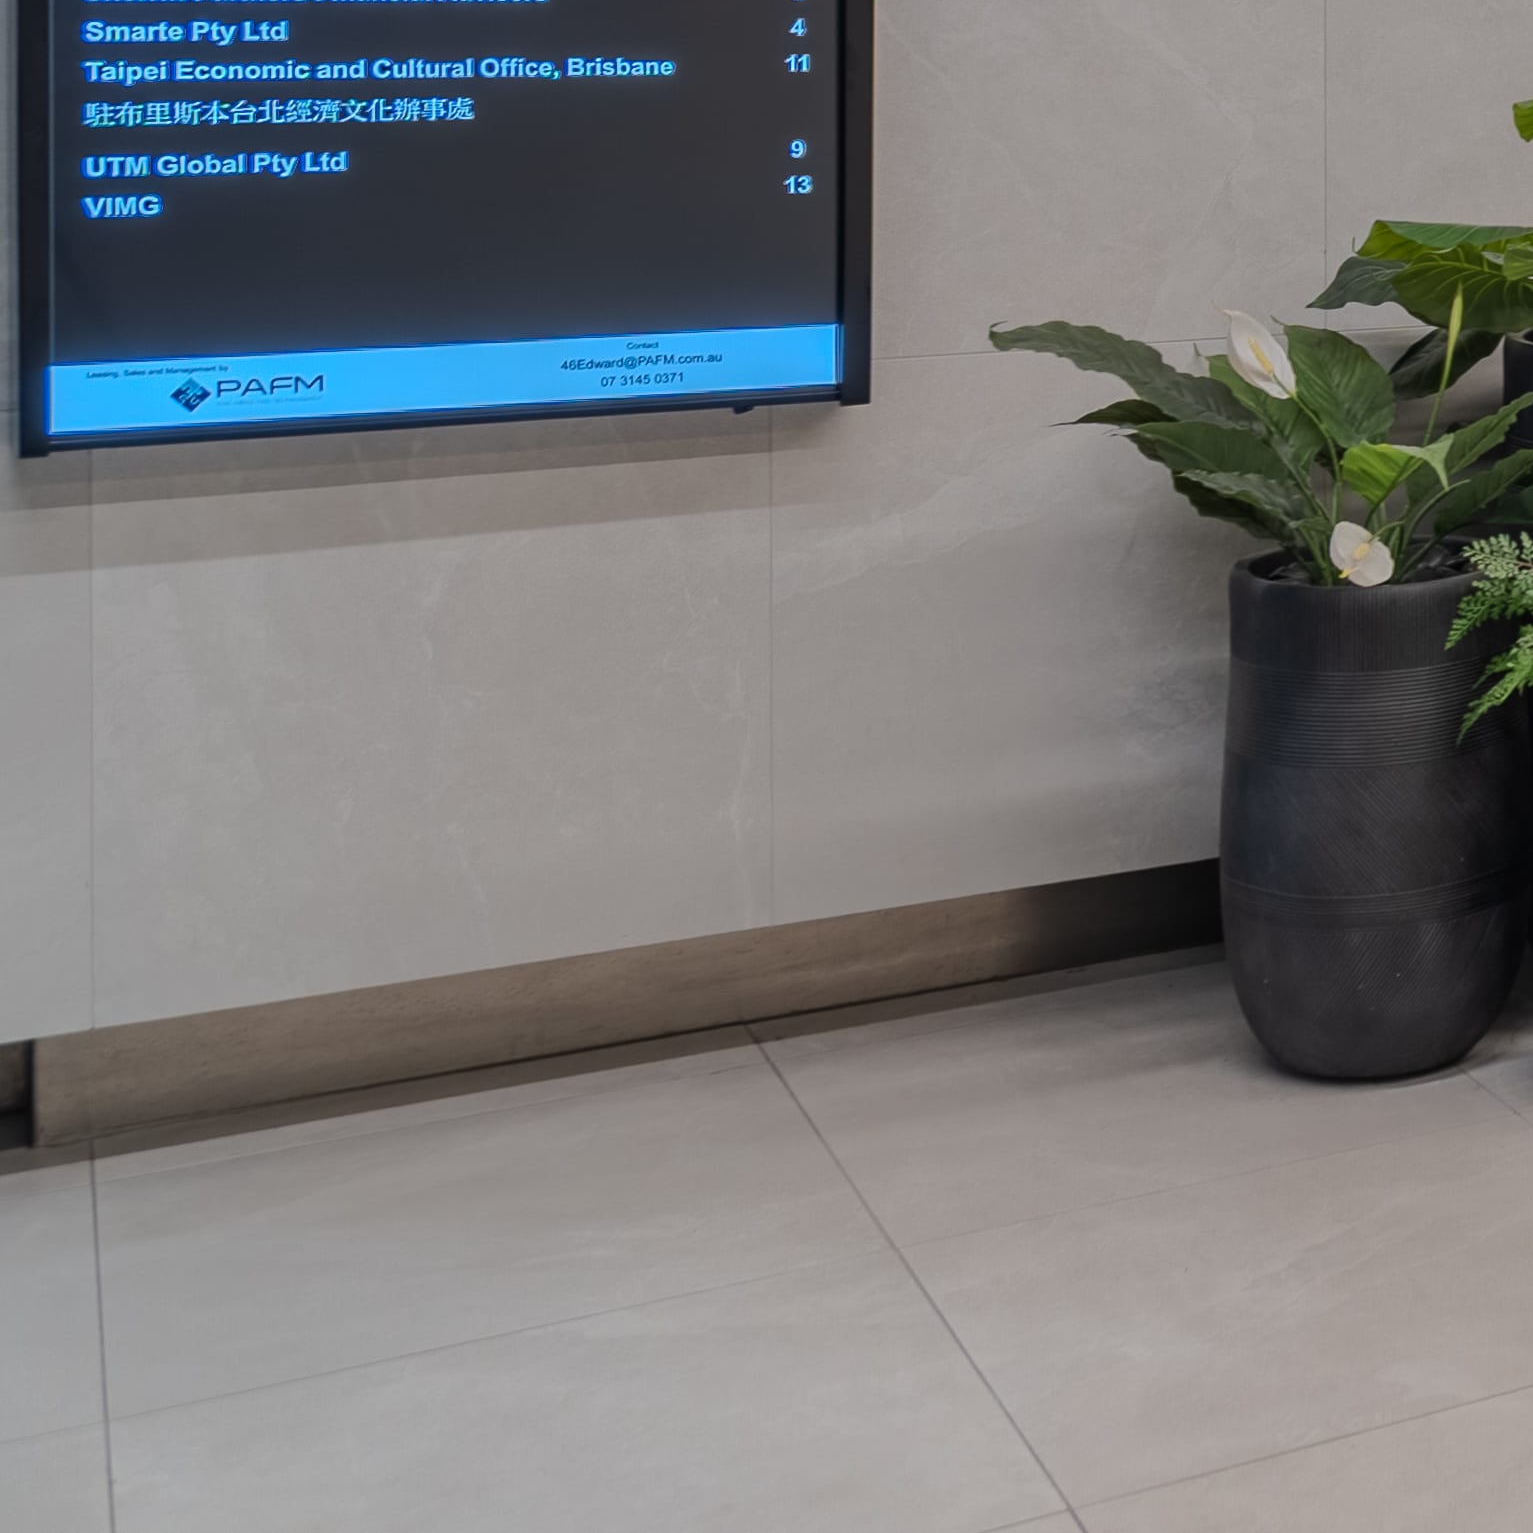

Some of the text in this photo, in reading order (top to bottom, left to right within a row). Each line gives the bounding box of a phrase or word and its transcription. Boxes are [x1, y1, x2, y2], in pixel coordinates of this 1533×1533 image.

[85, 20, 289, 46] Smarte Pty Ltd
[789, 17, 807, 37] 4
[83, 57, 676, 87] Taipei Economic and Cultural Office, Brisbane
[784, 53, 810, 73] 11
[83, 96, 475, 126] 駐布里斯本台北經濟文化辦事處
[790, 139, 807, 159] 9
[86, 150, 348, 178] UTM Global Pty Ltd
[783, 175, 813, 194] 13
[83, 195, 161, 218] VIMG
[626, 341, 660, 351] Contact
[560, 353, 723, 371] 46Edward@PAFM.com.au
[216, 374, 325, 398] PAFM
[600, 372, 685, 388] 07 3145 0371
